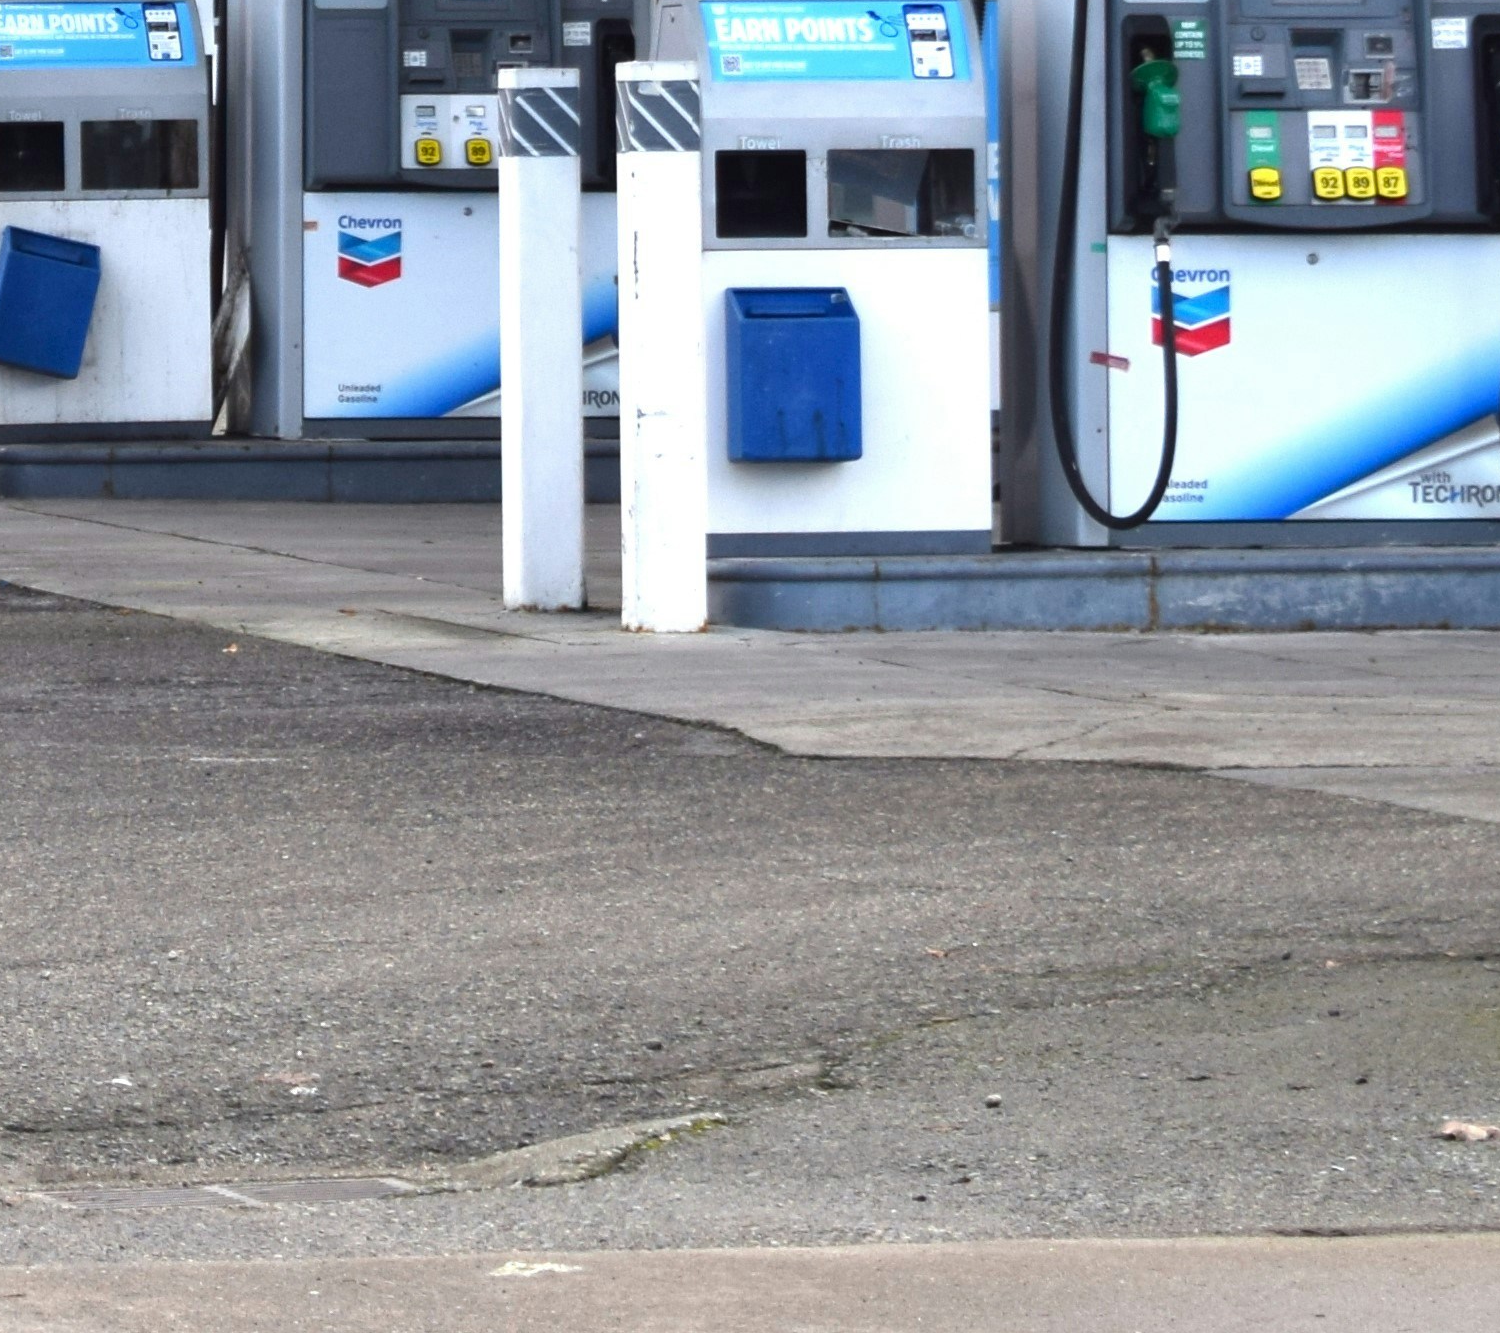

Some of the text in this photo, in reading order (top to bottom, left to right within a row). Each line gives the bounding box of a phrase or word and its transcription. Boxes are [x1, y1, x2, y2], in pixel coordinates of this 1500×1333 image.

[50, 12, 119, 33] POINTS
[714, 16, 874, 42] EARN POINTS
[9, 110, 42, 121] Towel
[739, 136, 781, 149] Towel
[880, 135, 921, 148] Trash
[420, 146, 436, 157] 92
[471, 146, 486, 157] 89
[1320, 176, 1338, 189] 92
[1352, 176, 1370, 189] 89
[1383, 176, 1399, 189] 87
[338, 215, 402, 229] Chevron
[1151, 267, 1231, 283] Cevron
[338, 384, 381, 393] Unleaded
[338, 395, 378, 404] Gasoline
[1420, 471, 1451, 483] with
